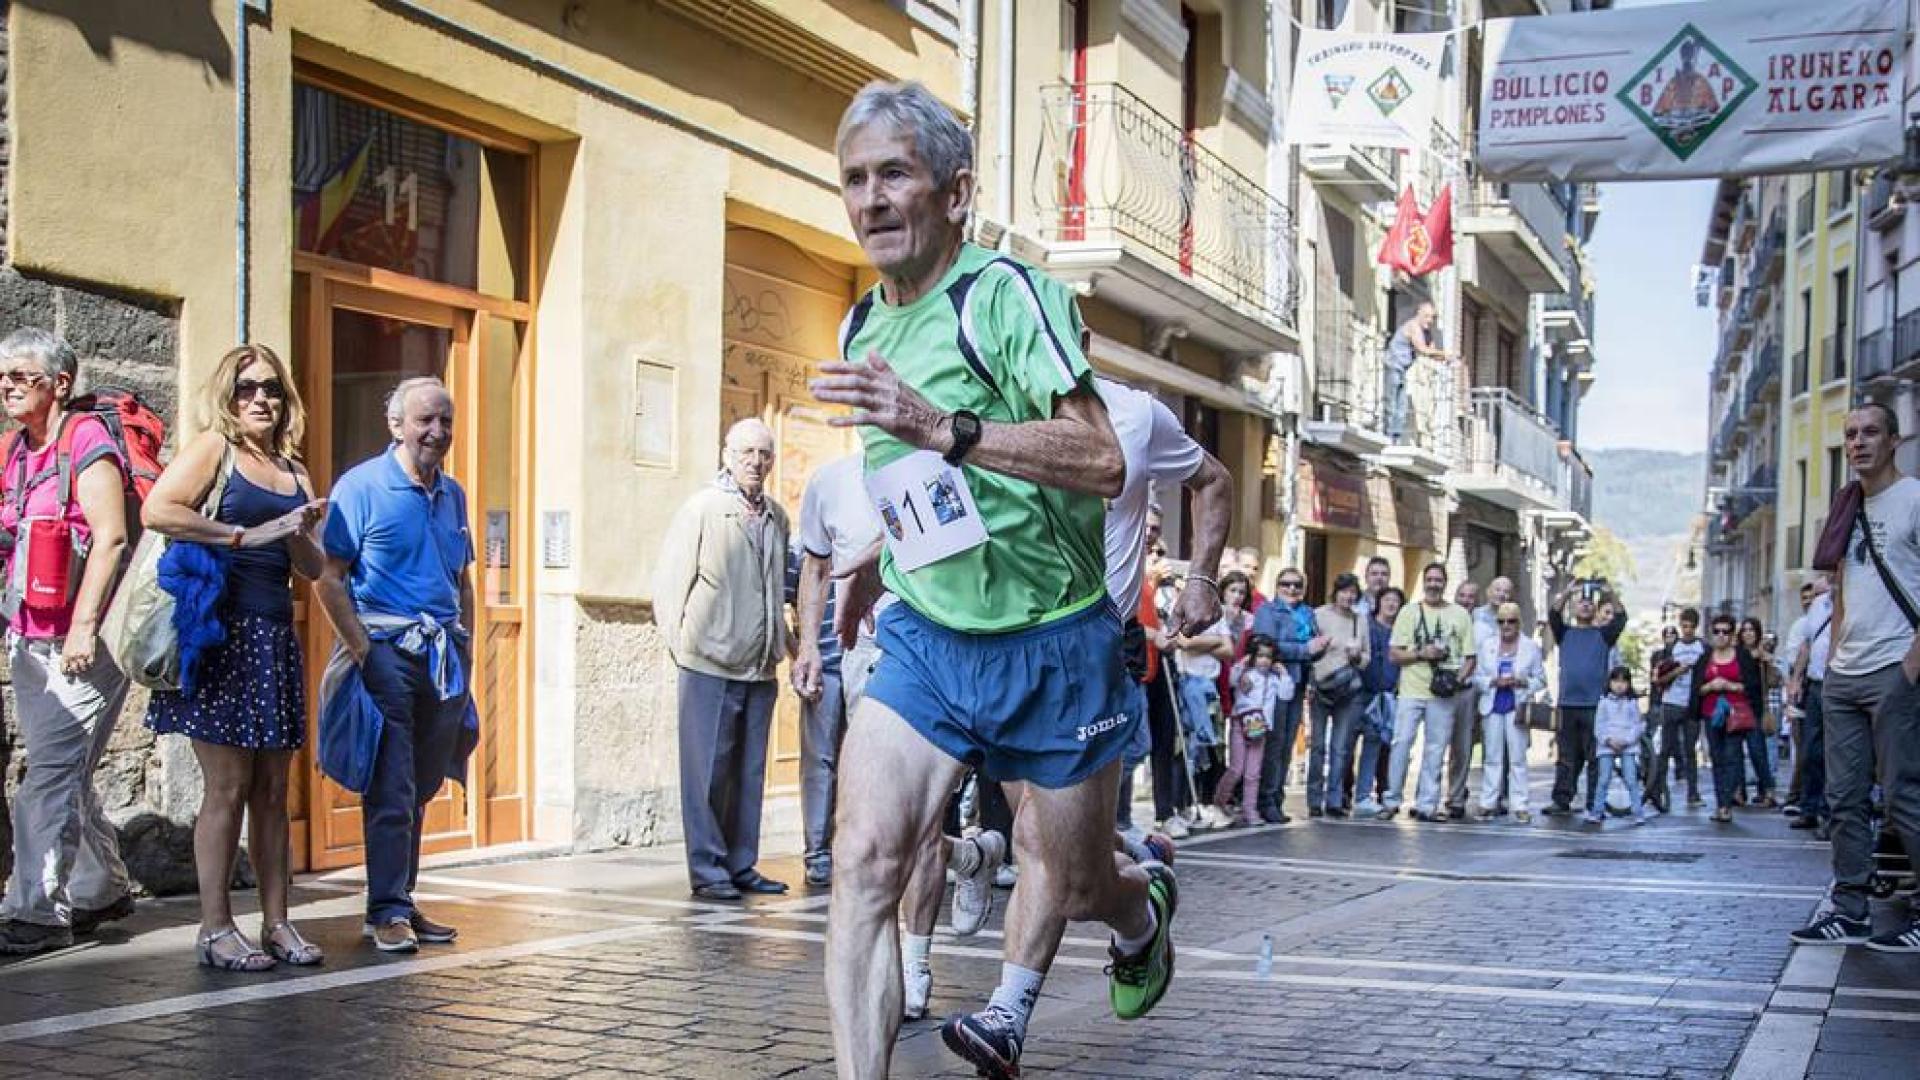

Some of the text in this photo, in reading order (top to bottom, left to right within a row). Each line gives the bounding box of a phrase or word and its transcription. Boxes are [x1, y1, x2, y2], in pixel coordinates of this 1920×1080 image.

[1492, 71, 1609, 101] BULLICIO
[1767, 83, 1889, 113] ALGARA
[375, 166, 418, 231] 11
[903, 489, 924, 534] 1
